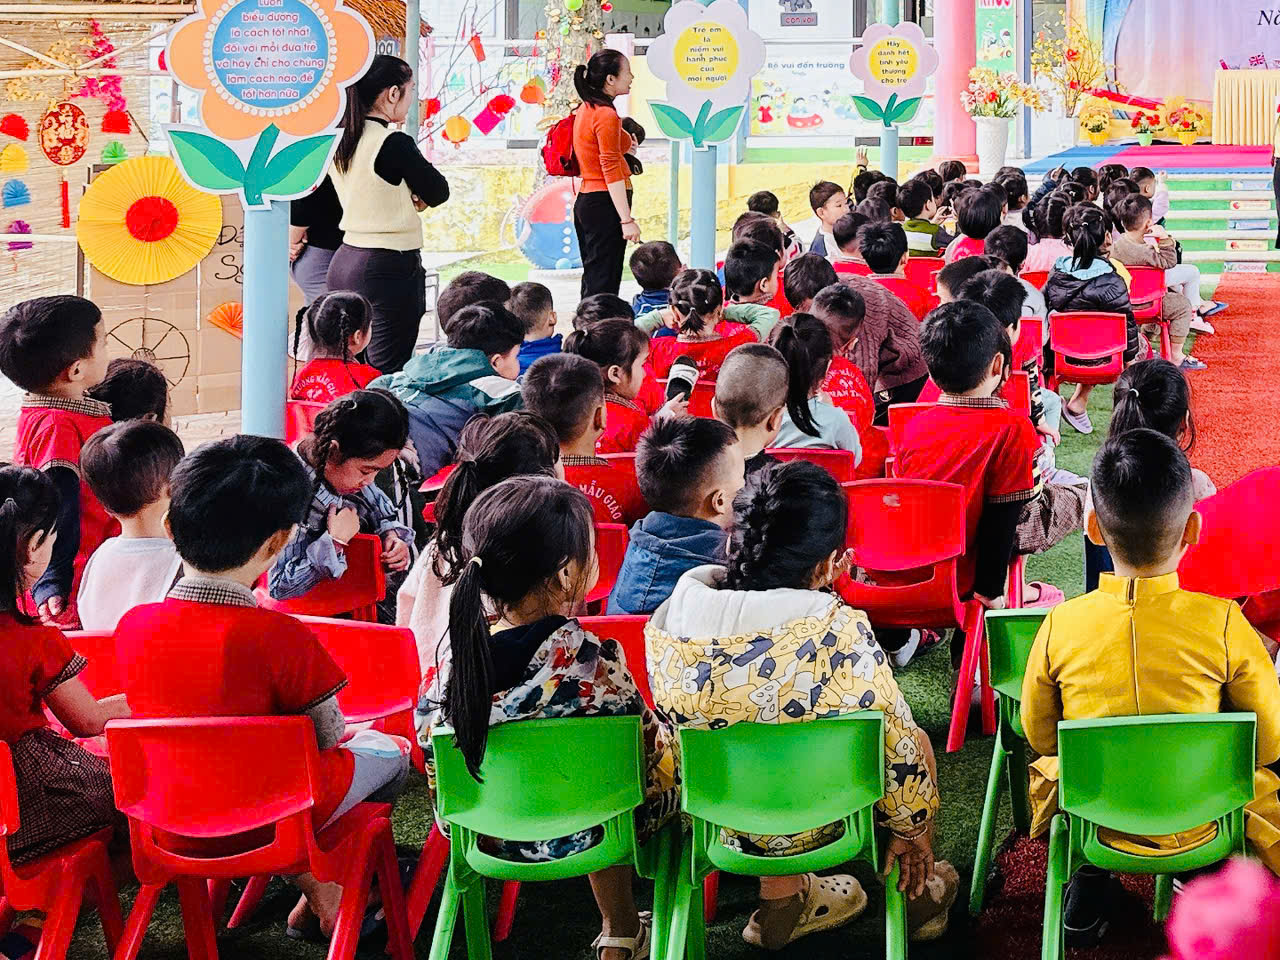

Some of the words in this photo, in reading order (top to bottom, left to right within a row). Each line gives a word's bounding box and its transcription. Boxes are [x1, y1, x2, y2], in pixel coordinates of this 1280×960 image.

[242, 10, 264, 22] biểu
[785, 16, 800, 24] con
[271, 58, 290, 68] cho
[579, 479, 606, 499] MẪU
[603, 494, 622, 520] GIÁO
